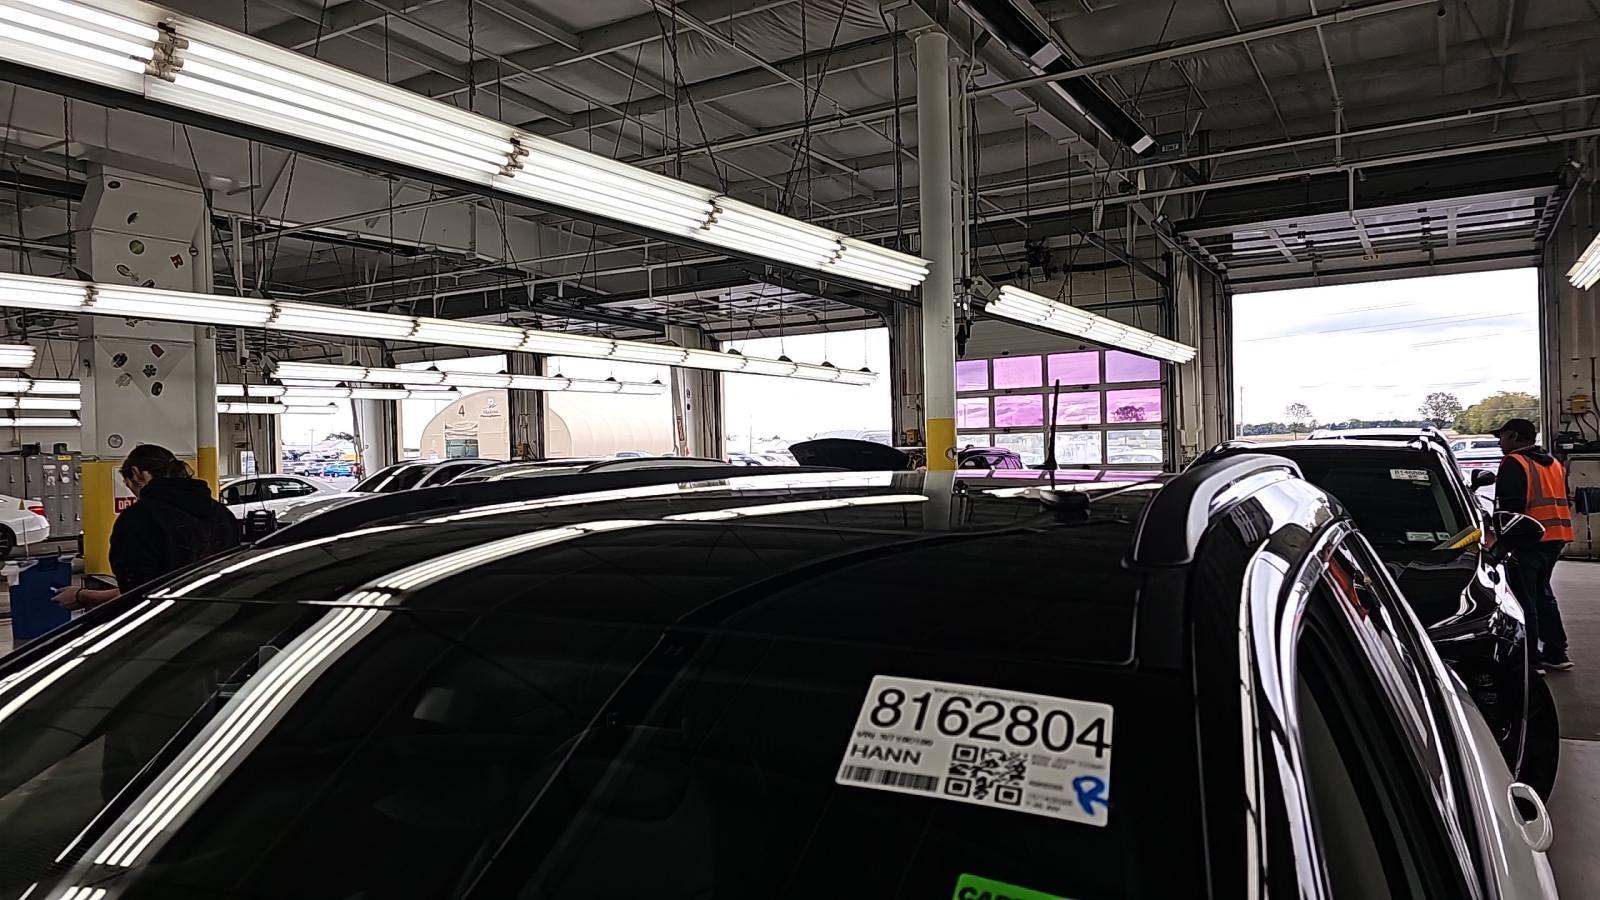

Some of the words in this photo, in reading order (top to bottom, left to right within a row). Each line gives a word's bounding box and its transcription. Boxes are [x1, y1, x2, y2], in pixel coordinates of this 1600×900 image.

[458, 404, 465, 417] 4
[870, 688, 1112, 758] 8162804
[850, 744, 922, 766] HANN
[1072, 776, 1110, 816] R
